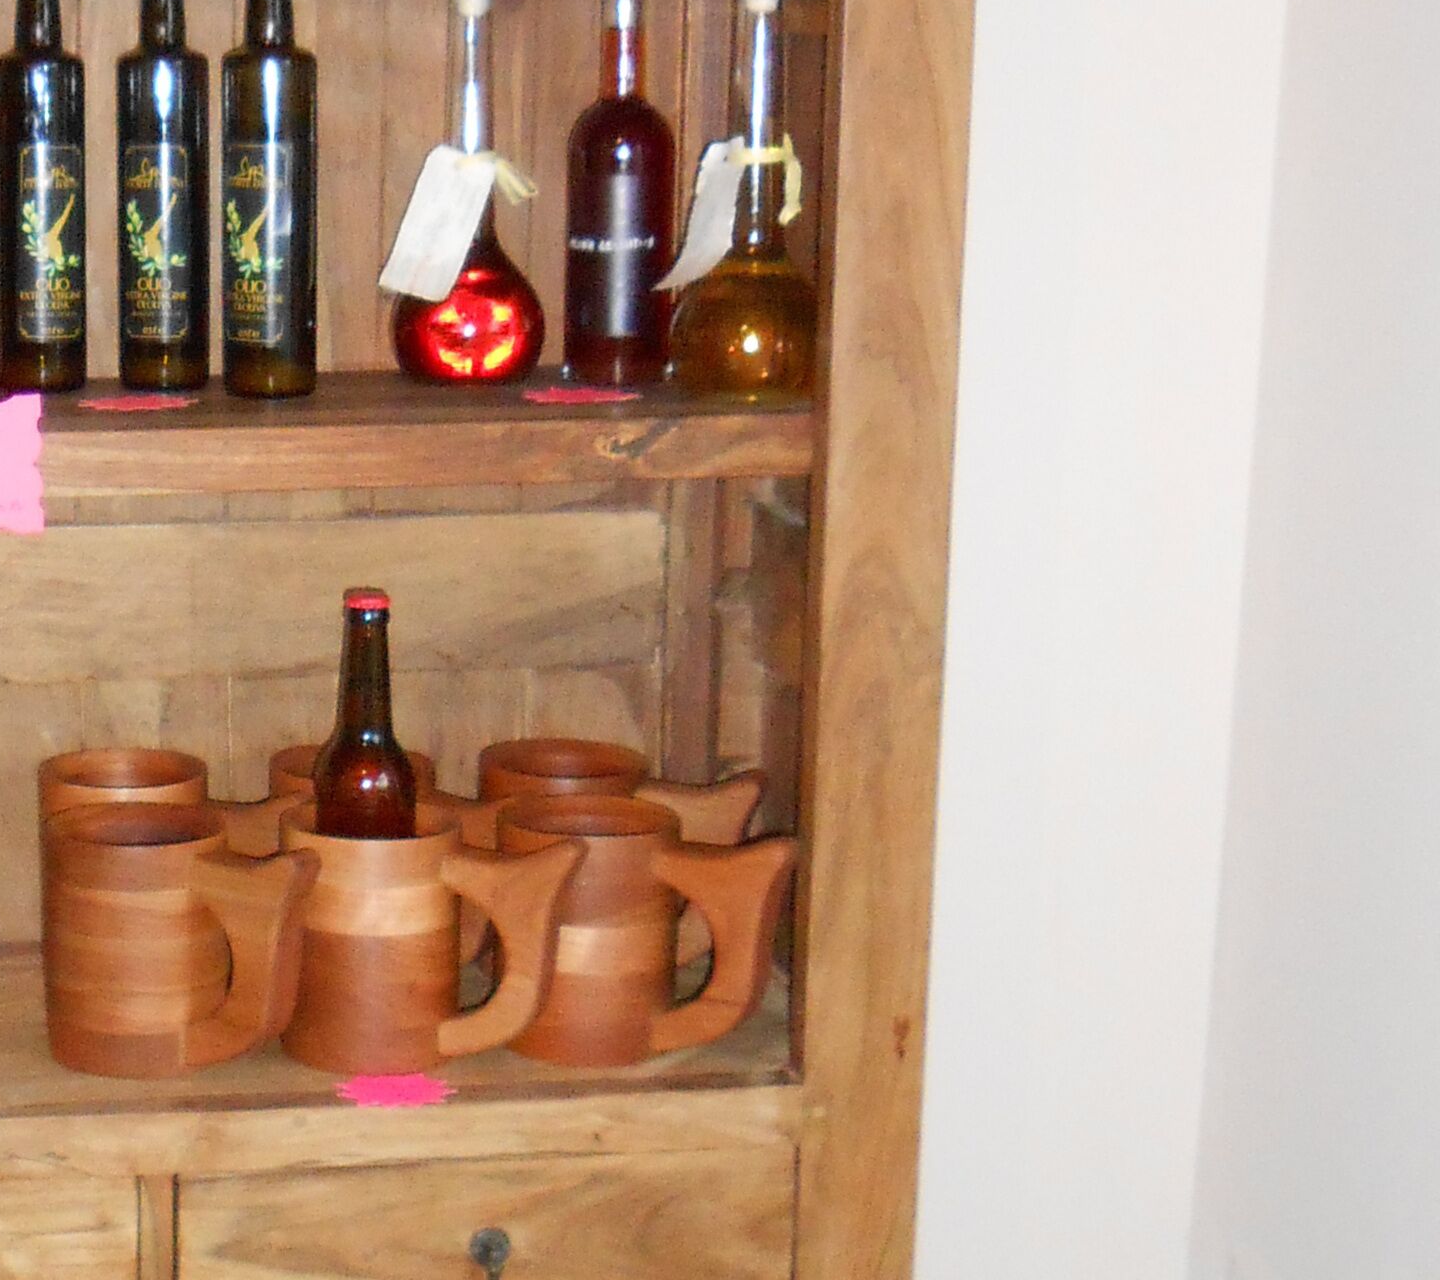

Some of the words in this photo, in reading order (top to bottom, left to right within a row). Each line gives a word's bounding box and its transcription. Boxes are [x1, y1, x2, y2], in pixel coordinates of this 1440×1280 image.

[35, 276, 71, 291] OLIO
[136, 276, 172, 291] OLIO
[234, 278, 267, 294] OLIO
